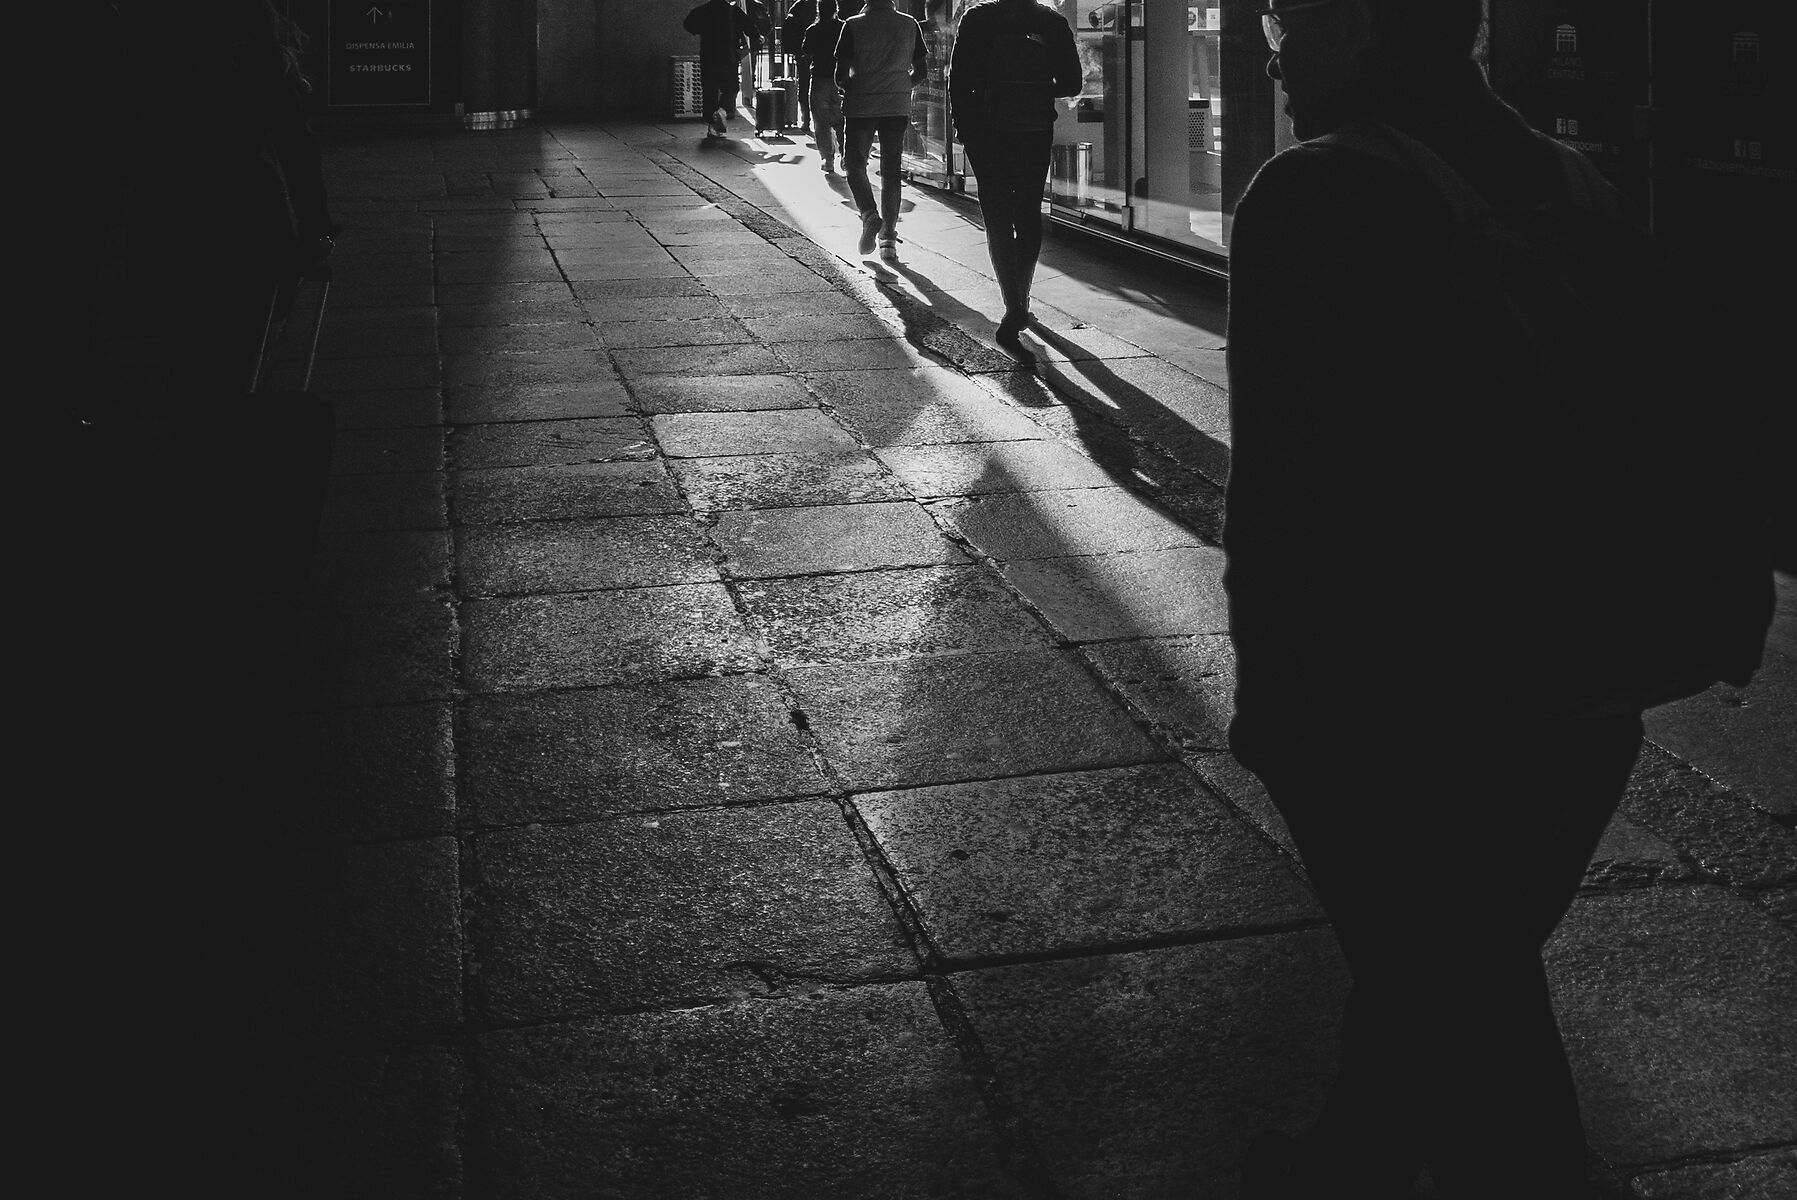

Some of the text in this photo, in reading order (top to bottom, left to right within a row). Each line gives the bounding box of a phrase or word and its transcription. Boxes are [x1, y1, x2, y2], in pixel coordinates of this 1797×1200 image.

[345, 41, 415, 50] DISPENSA EMILIA
[349, 64, 412, 72] STARBUCKS
